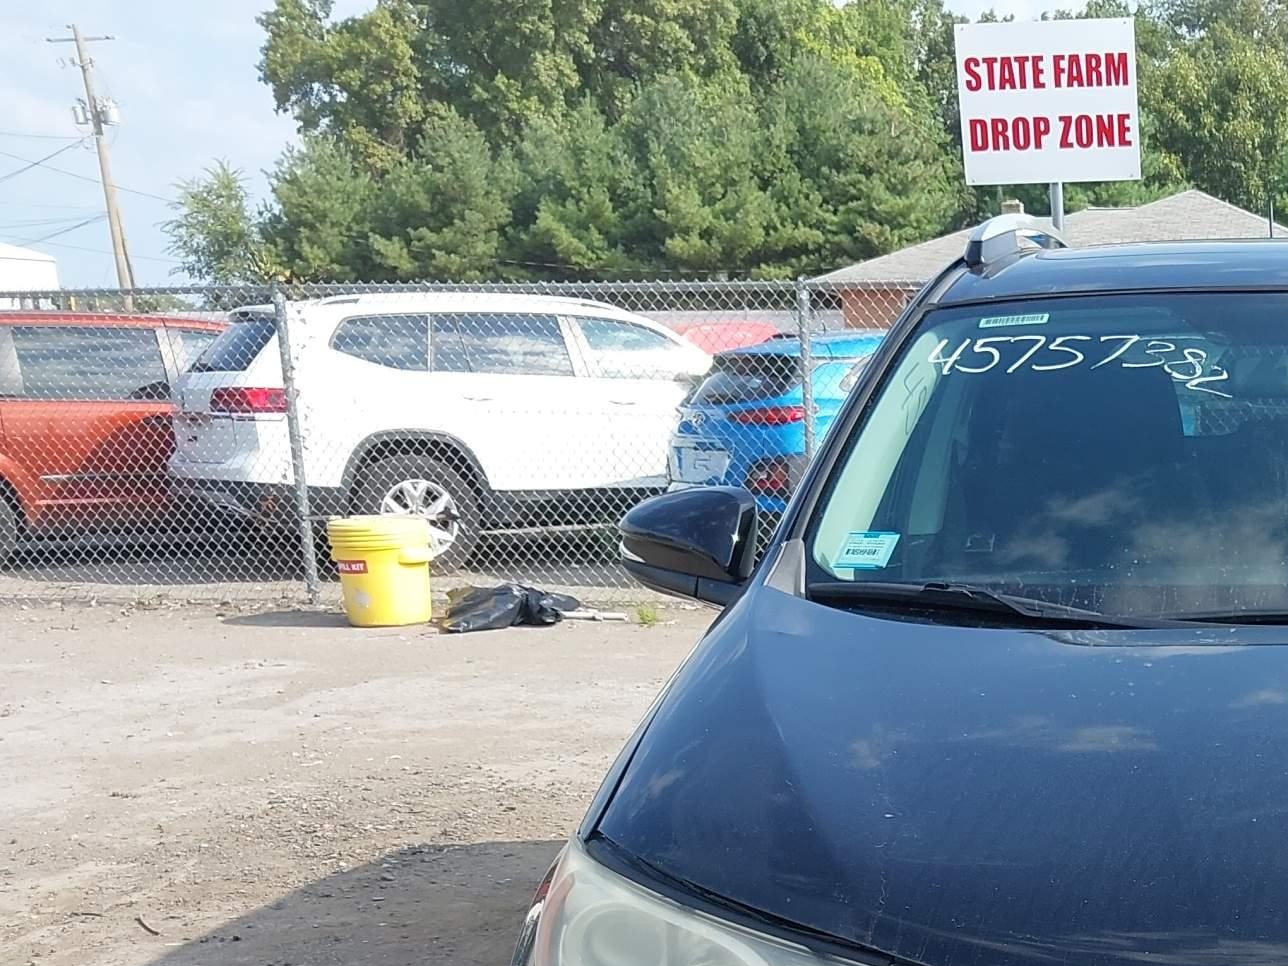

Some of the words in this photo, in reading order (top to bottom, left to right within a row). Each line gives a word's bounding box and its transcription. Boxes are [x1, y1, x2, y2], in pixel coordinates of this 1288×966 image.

[964, 55, 1046, 92] STATE
[1053, 52, 1129, 88] FARM
[969, 116, 1051, 152] DROP
[1059, 113, 1132, 149] ZONE
[927, 335, 1232, 398] 45757382
[338, 562, 351, 571] PILL
[352, 563, 364, 571] KIT
